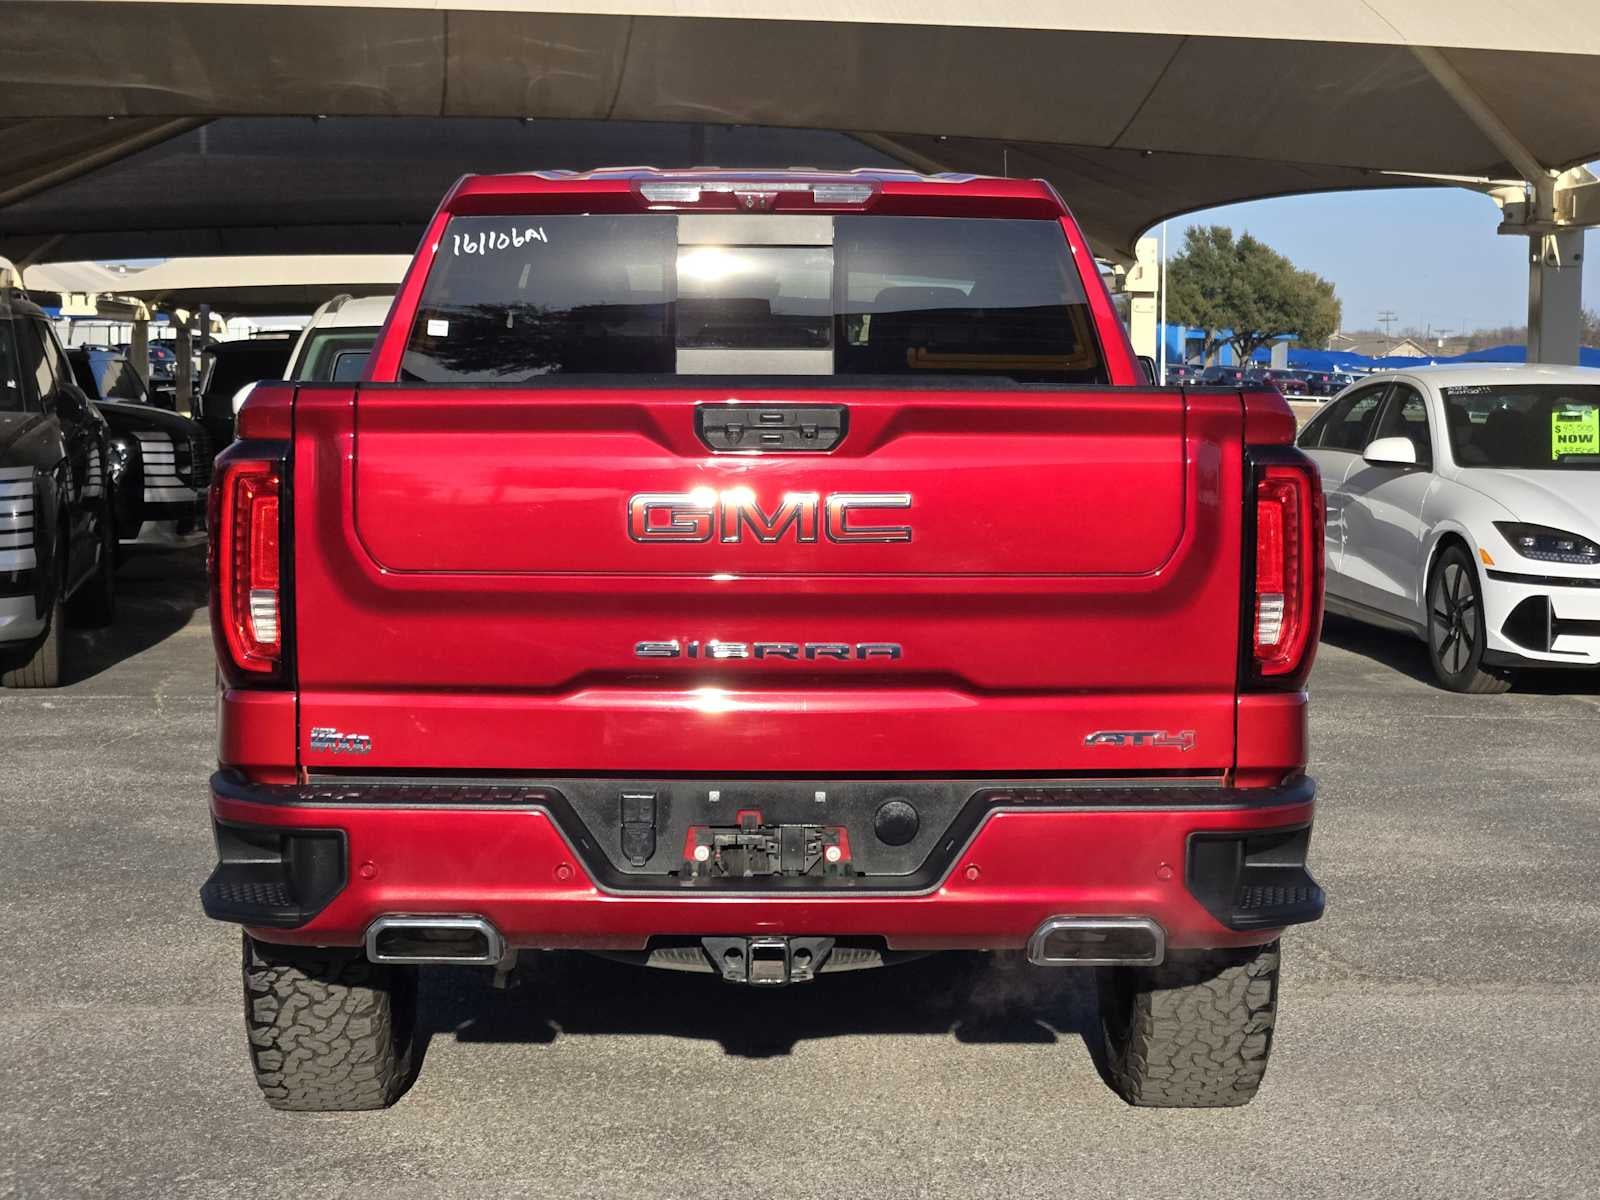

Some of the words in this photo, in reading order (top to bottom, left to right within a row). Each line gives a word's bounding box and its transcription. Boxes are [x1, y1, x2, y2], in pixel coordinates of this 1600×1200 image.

[1557, 434, 1593, 443] NOW
[627, 491, 912, 544] GMC
[635, 640, 901, 660] SIERRA
[1084, 730, 1195, 752] AT4
